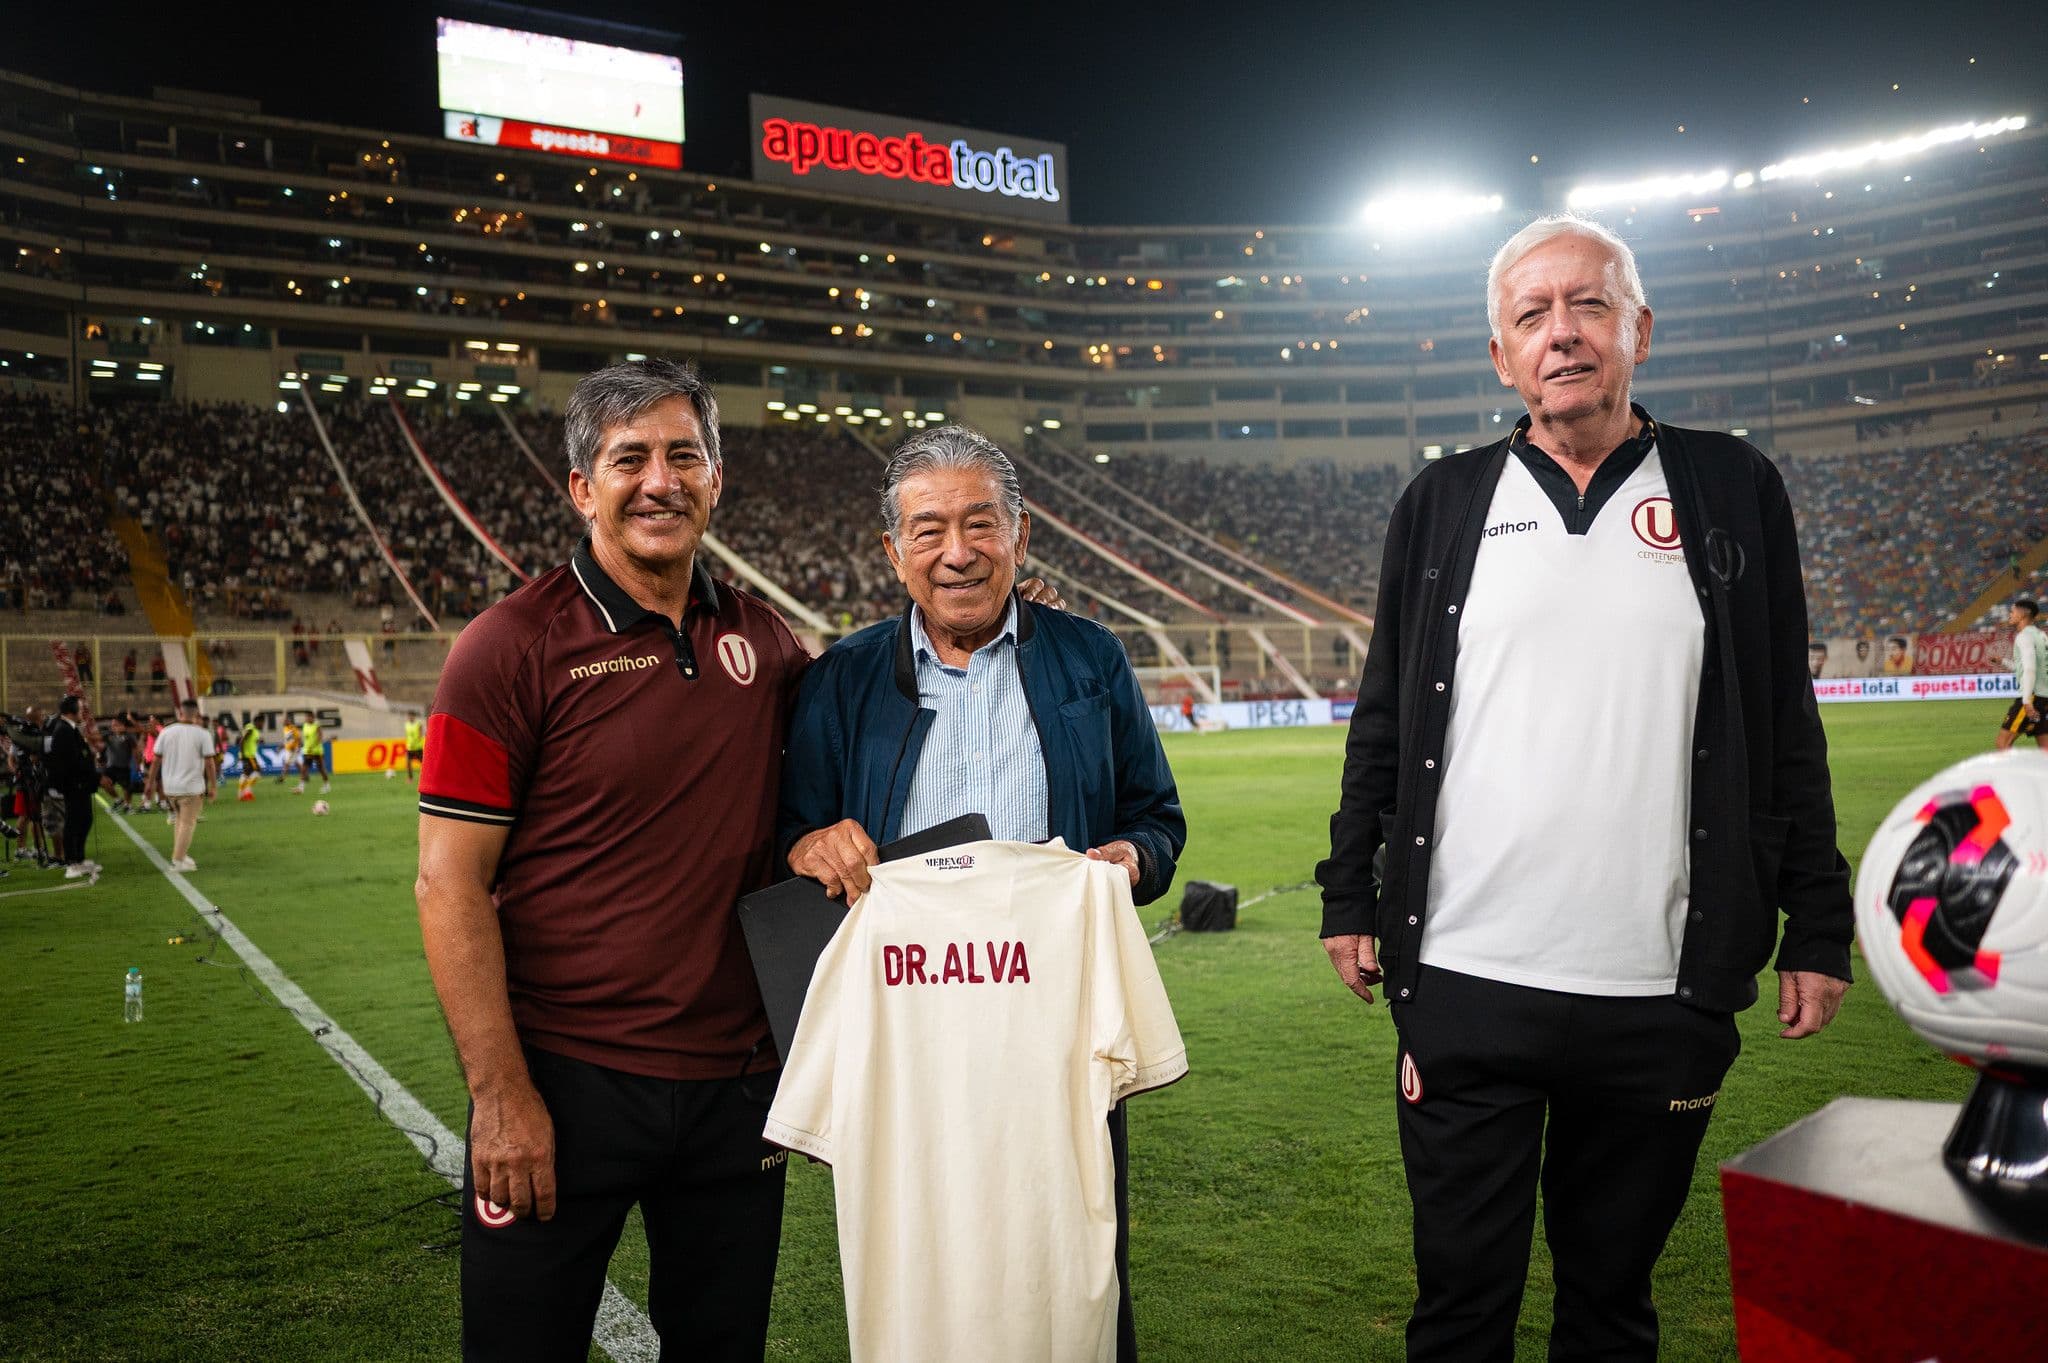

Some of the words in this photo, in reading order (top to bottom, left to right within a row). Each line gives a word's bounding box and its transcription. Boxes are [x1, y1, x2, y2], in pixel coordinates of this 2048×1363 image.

[762, 117, 1060, 202] apuestatotal
[569, 654, 660, 680] marathon
[883, 941, 1031, 986] DR.ALVA
